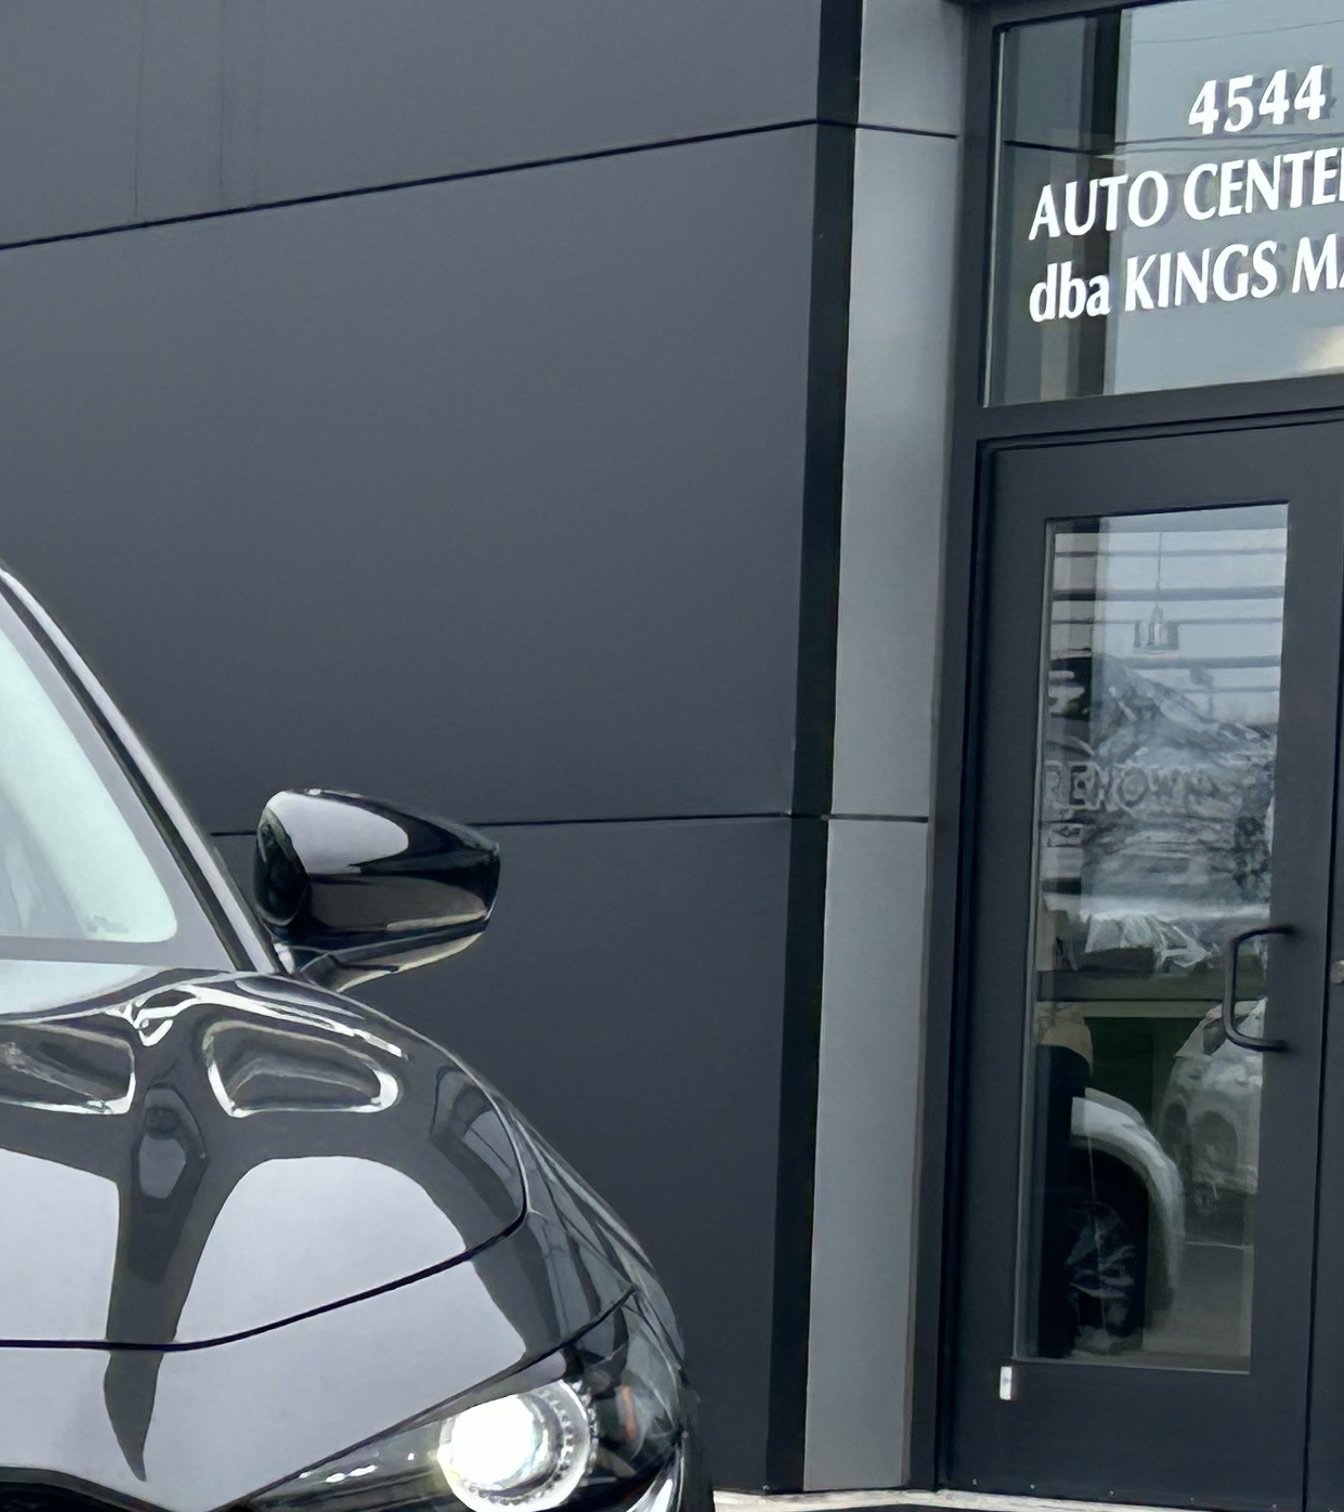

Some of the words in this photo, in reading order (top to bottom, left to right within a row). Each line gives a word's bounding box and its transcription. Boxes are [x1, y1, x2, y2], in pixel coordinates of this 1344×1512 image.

[1188, 64, 1326, 135] 4544
[1028, 170, 1169, 241] AUTO
[1183, 147, 1344, 221] CENTE
[1029, 261, 1110, 322] dba
[1125, 240, 1278, 311] KINGS
[1291, 233, 1344, 294] M
